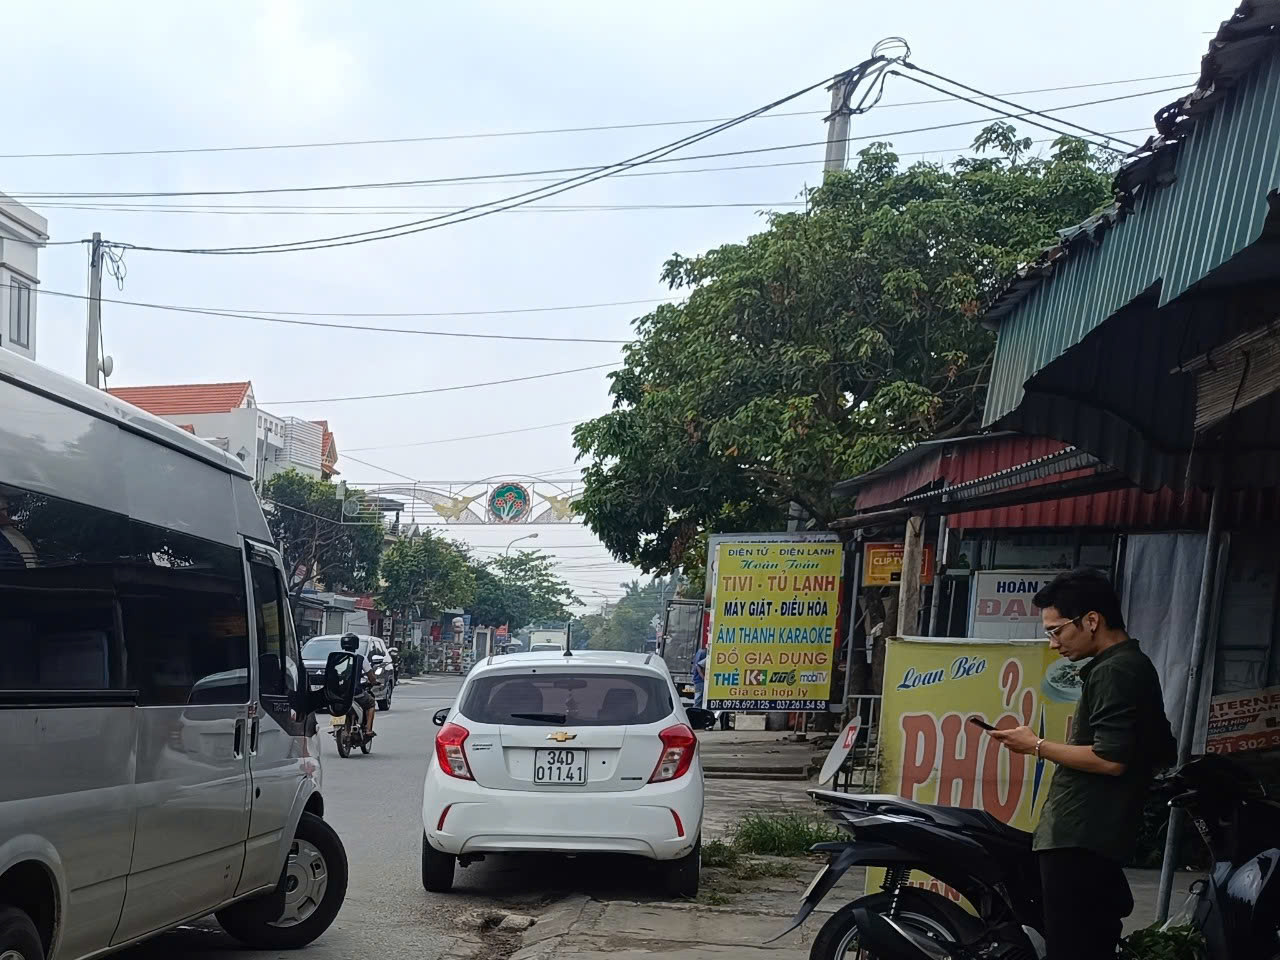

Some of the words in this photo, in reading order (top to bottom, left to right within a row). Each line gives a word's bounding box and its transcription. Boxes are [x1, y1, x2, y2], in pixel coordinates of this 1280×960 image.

[873, 557, 892, 565] CLIP
[723, 576, 753, 592] TIVI
[767, 570, 788, 592] TỦ
[793, 575, 836, 596] LẠNH
[997, 578, 1038, 593] HOÀN
[723, 597, 746, 617] MÁY
[749, 598, 772, 621] GIẶT
[780, 594, 804, 617] ĐIỀU
[807, 597, 828, 617] HÒA
[716, 624, 736, 644] ÂM
[739, 627, 775, 644] THANH
[778, 627, 832, 644] KARAOKE
[744, 652, 773, 665] GIA
[779, 652, 828, 668] DỤNG
[897, 667, 944, 691] Loan
[951, 656, 987, 680] Béo
[547, 751, 575, 765] 34D
[536, 766, 583, 782] 011.41
